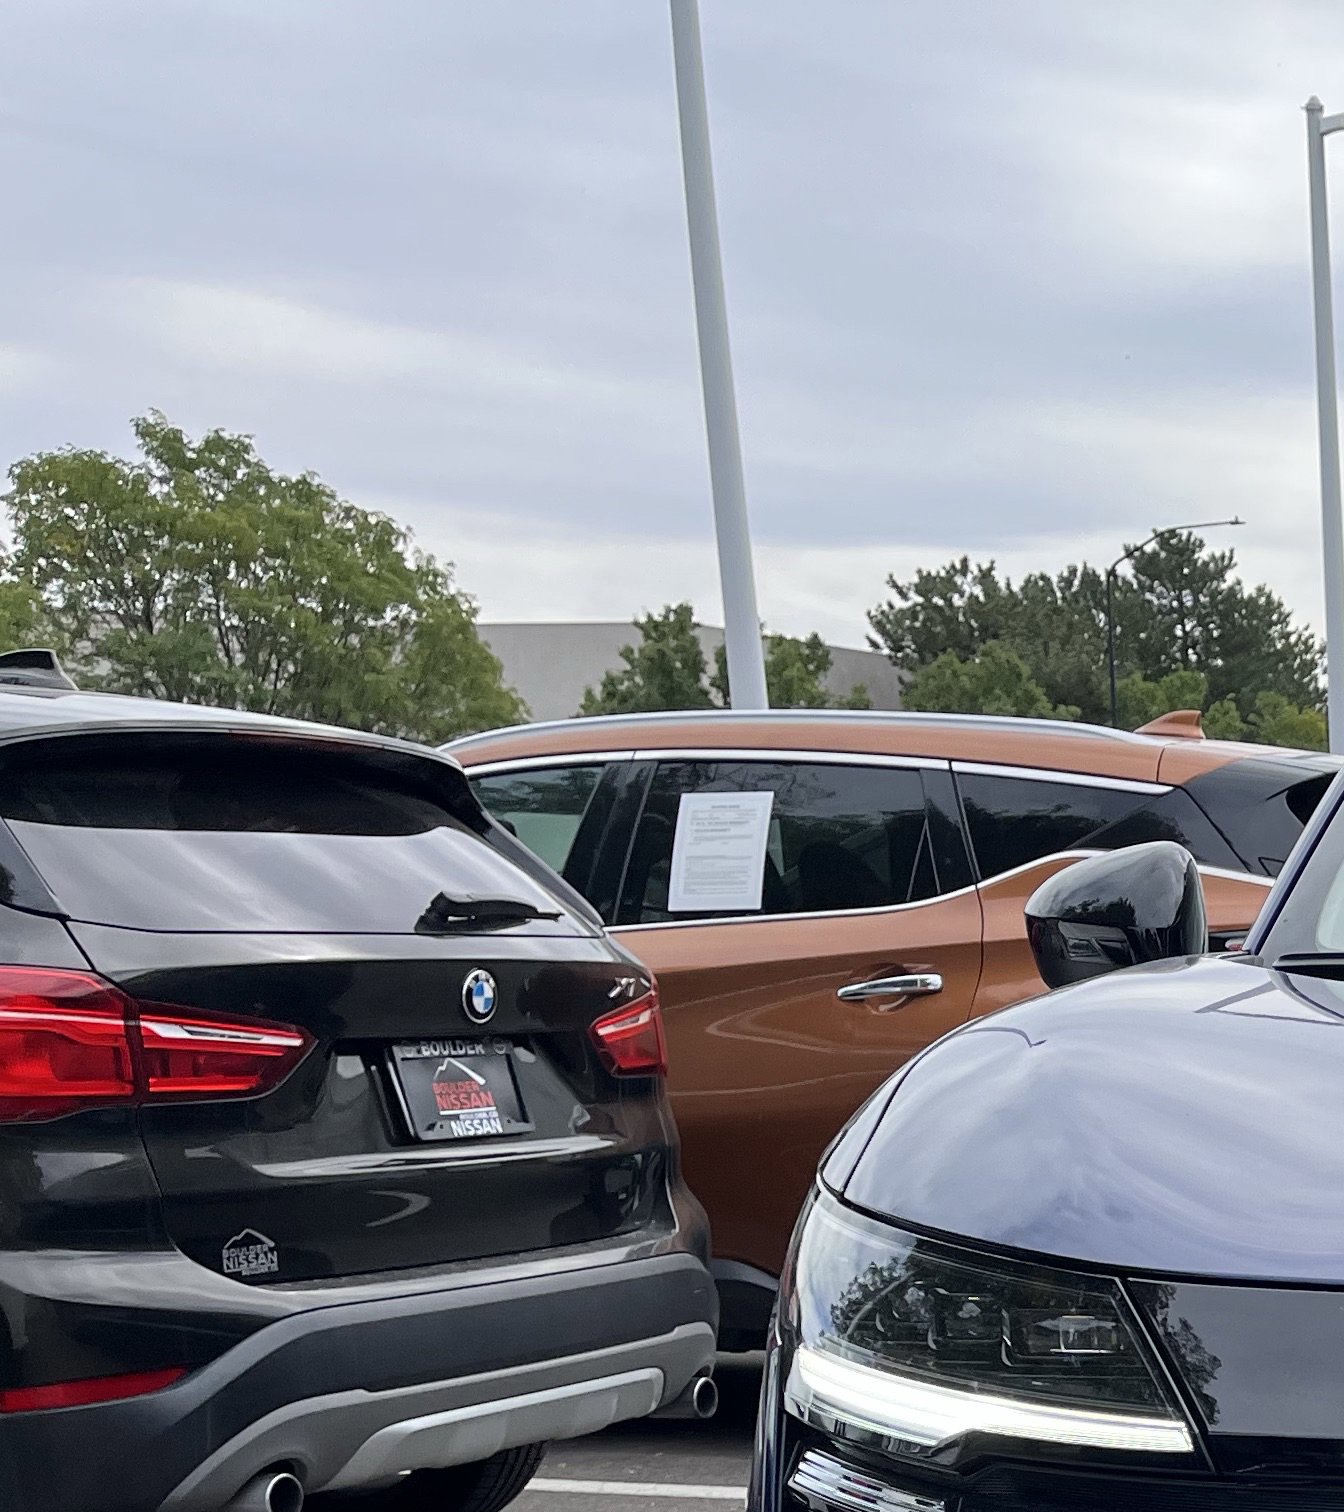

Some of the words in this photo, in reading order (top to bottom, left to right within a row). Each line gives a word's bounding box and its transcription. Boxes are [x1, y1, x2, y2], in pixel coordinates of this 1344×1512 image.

[420, 1040, 486, 1056] BOULDER
[431, 1081, 480, 1094] BOULDER
[435, 1091, 496, 1110] NISSAN
[450, 1118, 503, 1137] NISSAN
[223, 1250, 278, 1270] NISSAN
